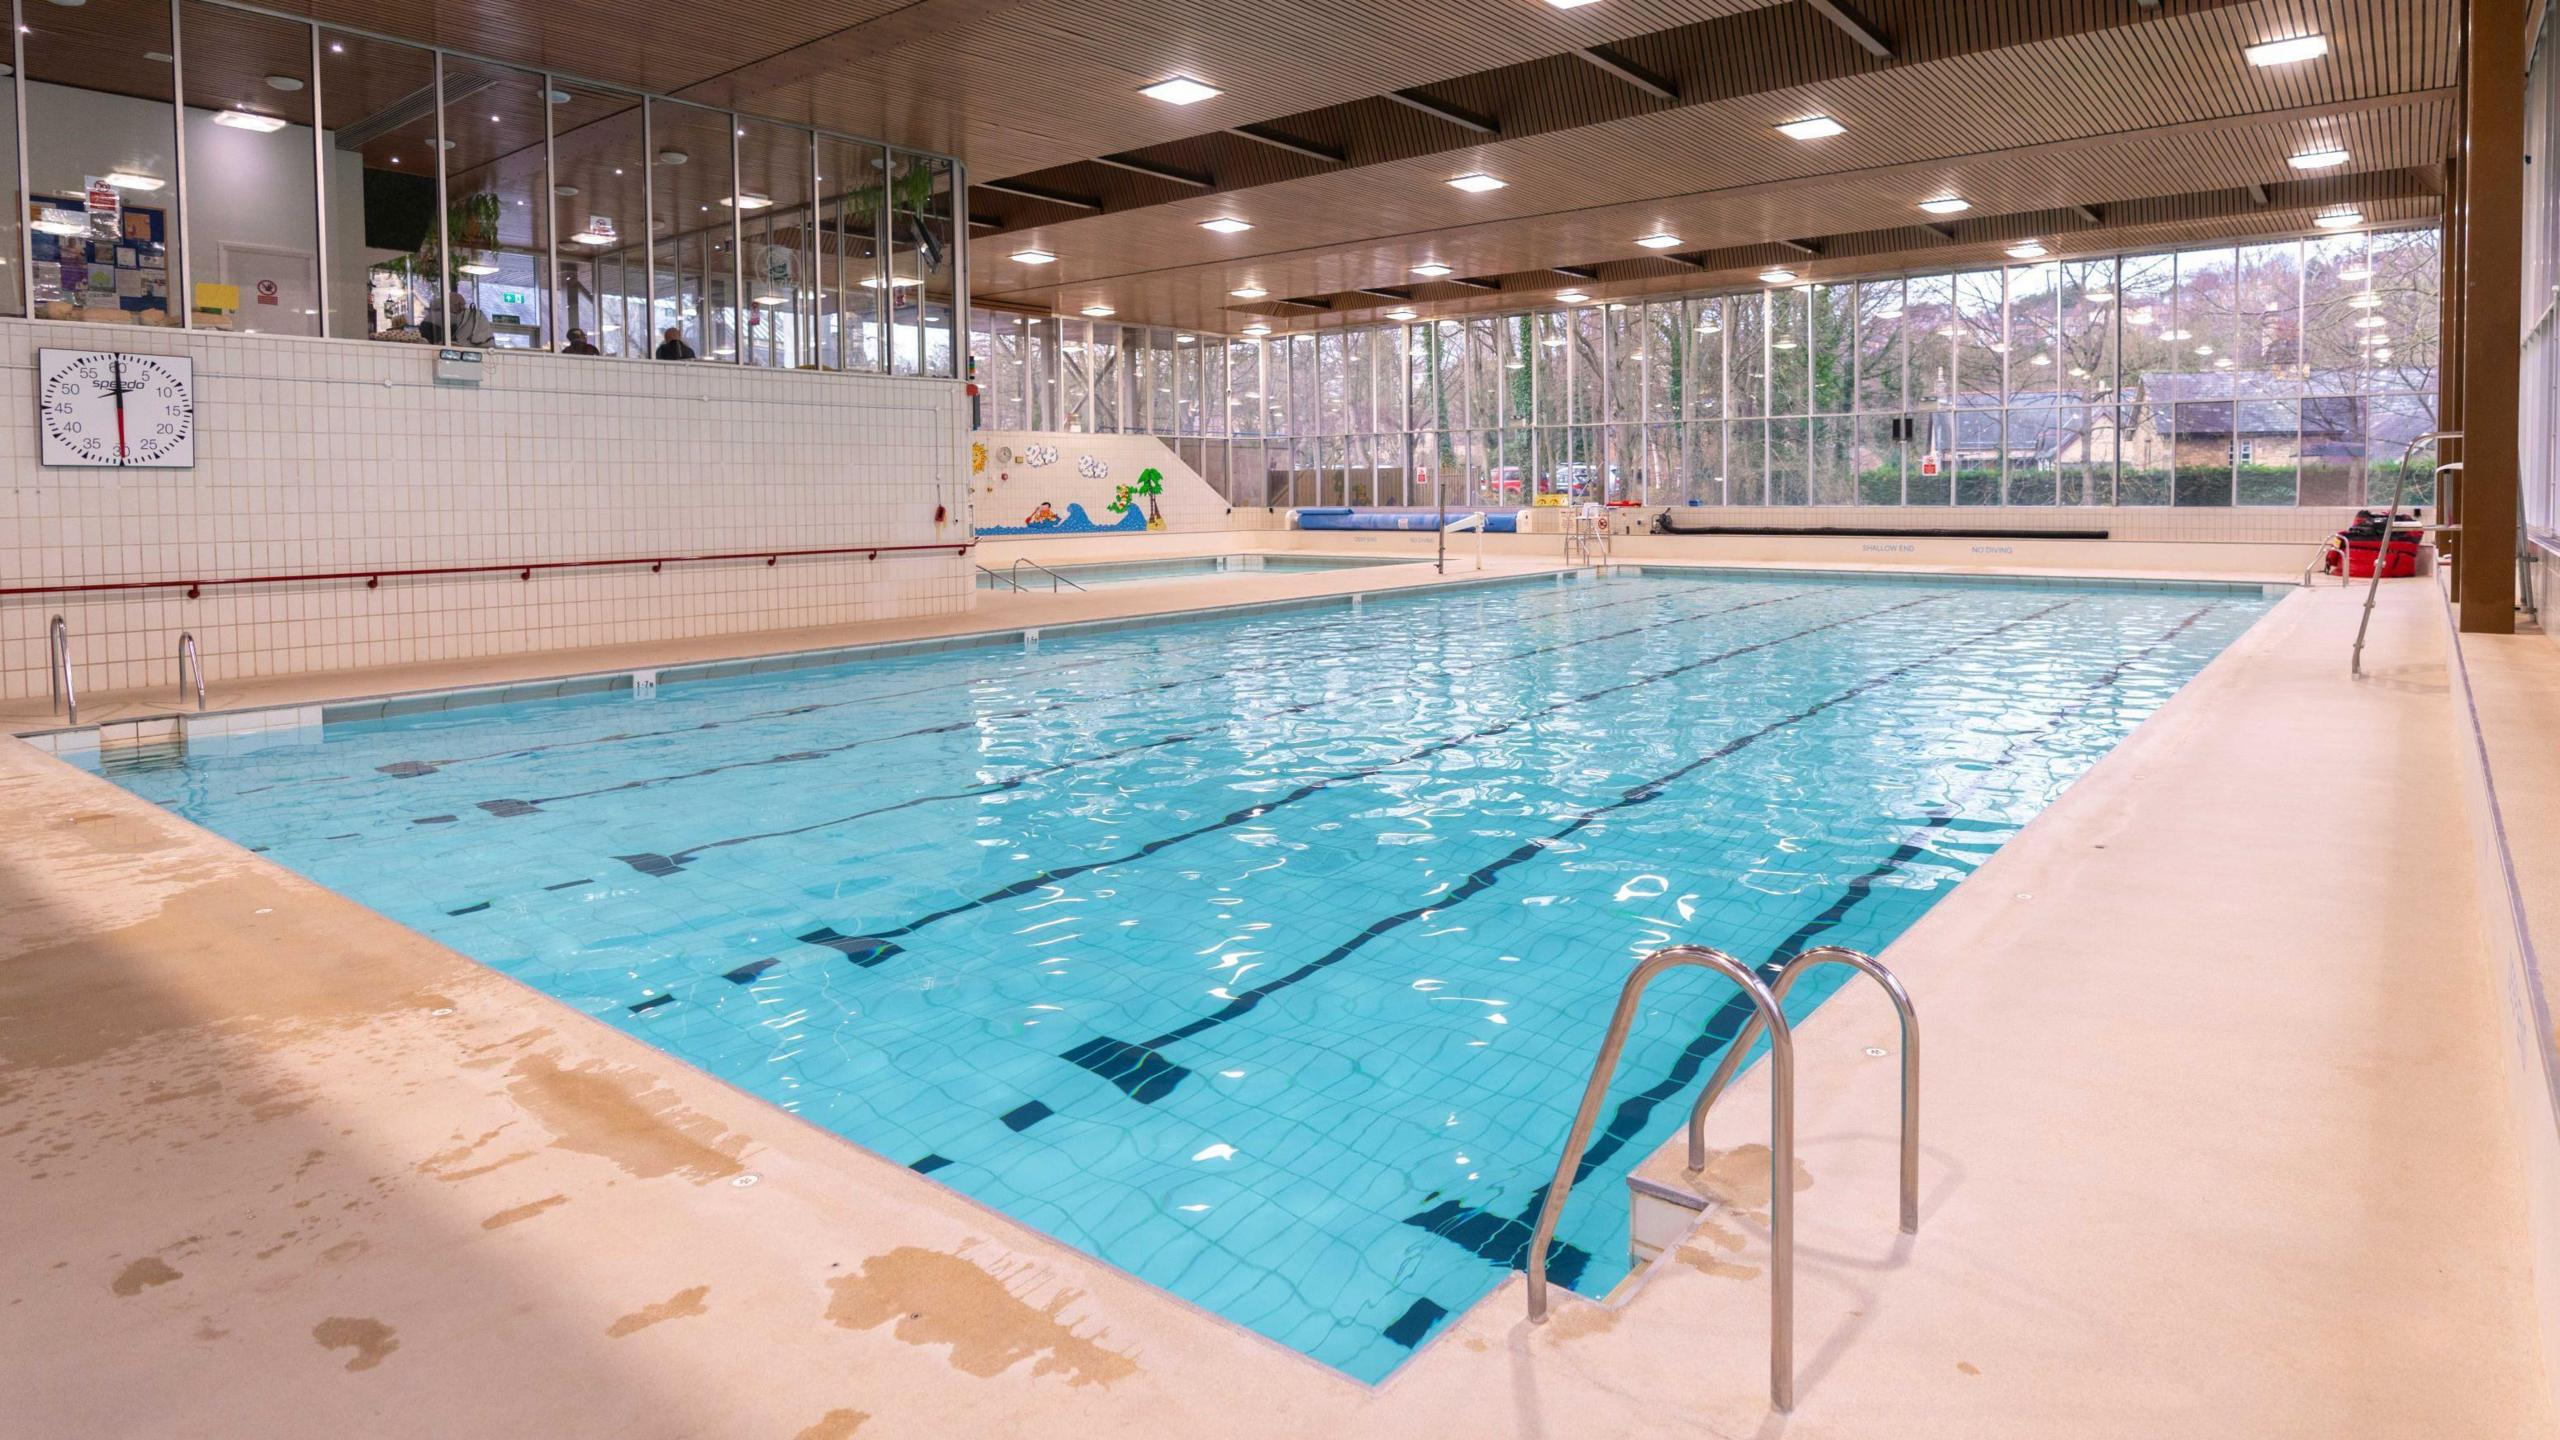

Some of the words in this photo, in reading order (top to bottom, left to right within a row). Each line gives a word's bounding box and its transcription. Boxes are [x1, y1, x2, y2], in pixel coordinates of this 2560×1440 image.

[79, 367, 98, 379] 55
[108, 362, 127, 374] 60
[141, 370, 150, 382] 5
[61, 383, 80, 395] 50
[92, 379, 145, 390] speedo
[156, 387, 172, 398] 10
[54, 402, 73, 414] 45
[165, 405, 181, 417] 15
[63, 421, 82, 433] 40
[156, 423, 174, 435] 20
[82, 437, 101, 449] 35
[140, 438, 158, 450] 25
[1862, 544, 1897, 552] SHALLOW
[1985, 546, 2013, 554] DIVING
